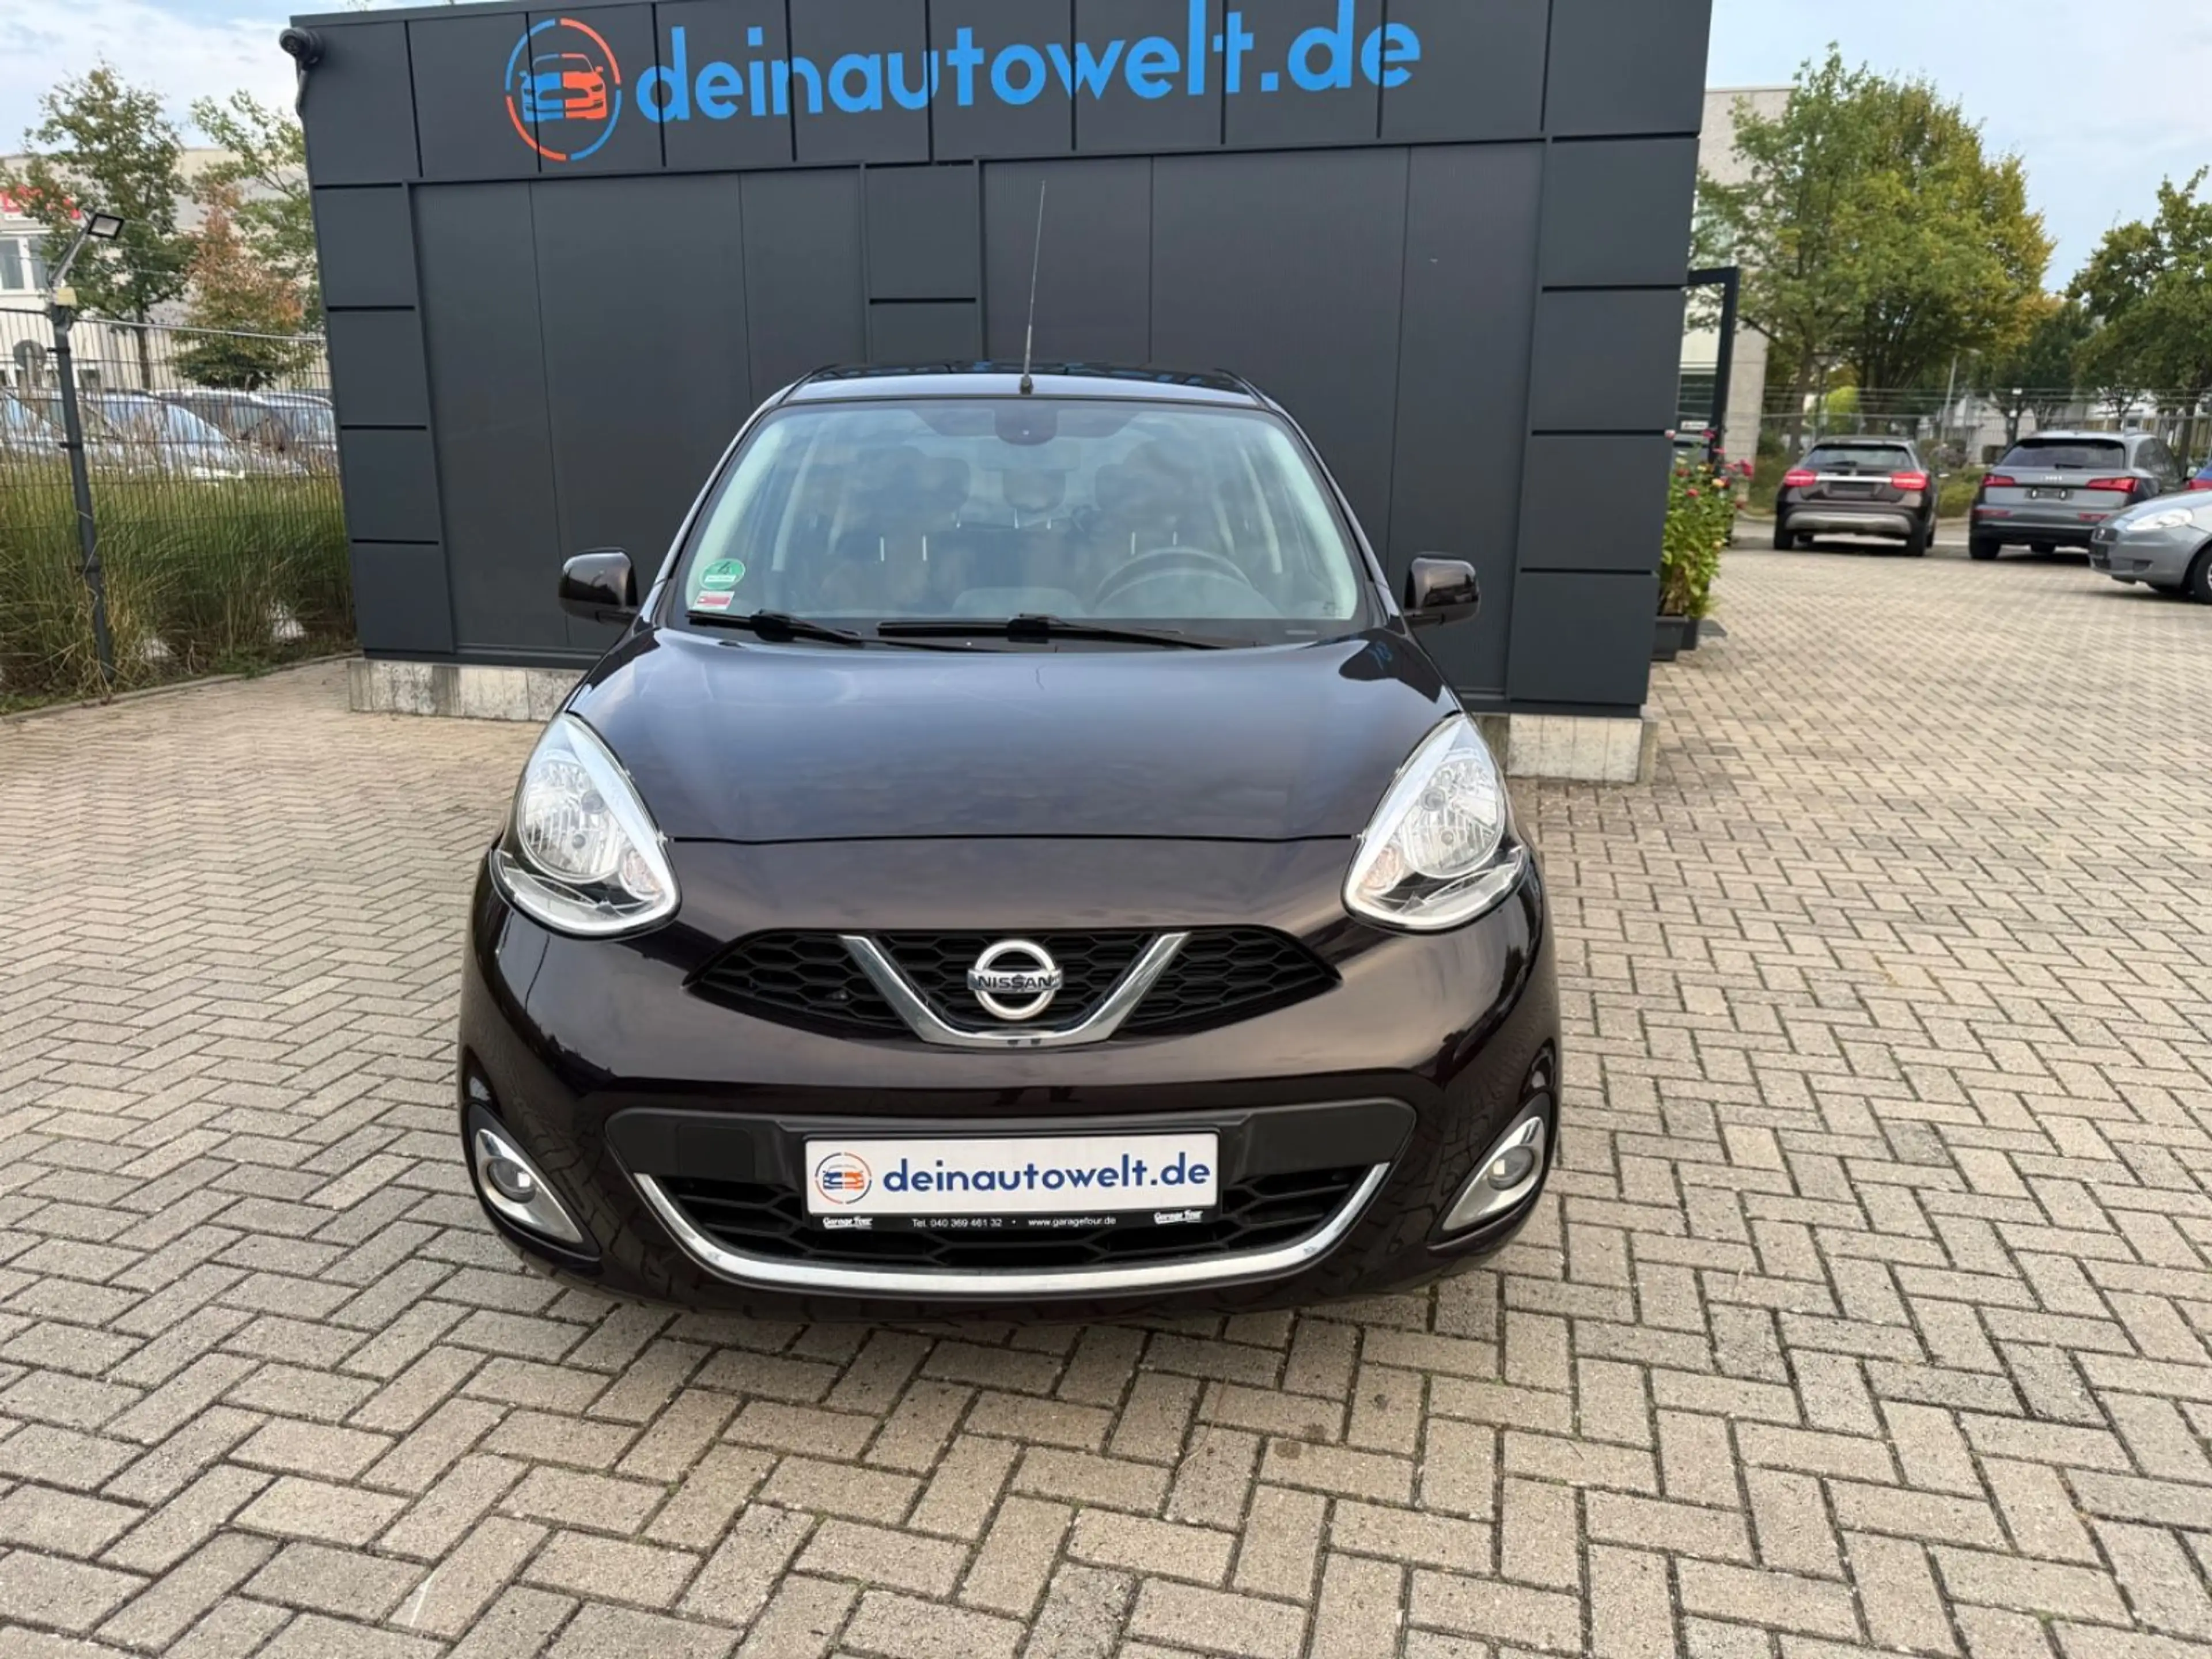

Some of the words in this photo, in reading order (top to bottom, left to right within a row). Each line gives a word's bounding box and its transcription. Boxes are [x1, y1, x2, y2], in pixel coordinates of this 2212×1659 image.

[635, 0, 1421, 123] deinautowelt.de
[978, 974, 1052, 988] NISSAN
[882, 1151, 1210, 1192] deinautowelt.de
[929, 1218, 949, 1228] 040
[990, 1217, 1002, 1228] 32
[1028, 1216, 1116, 1228] www.garagefour.de
